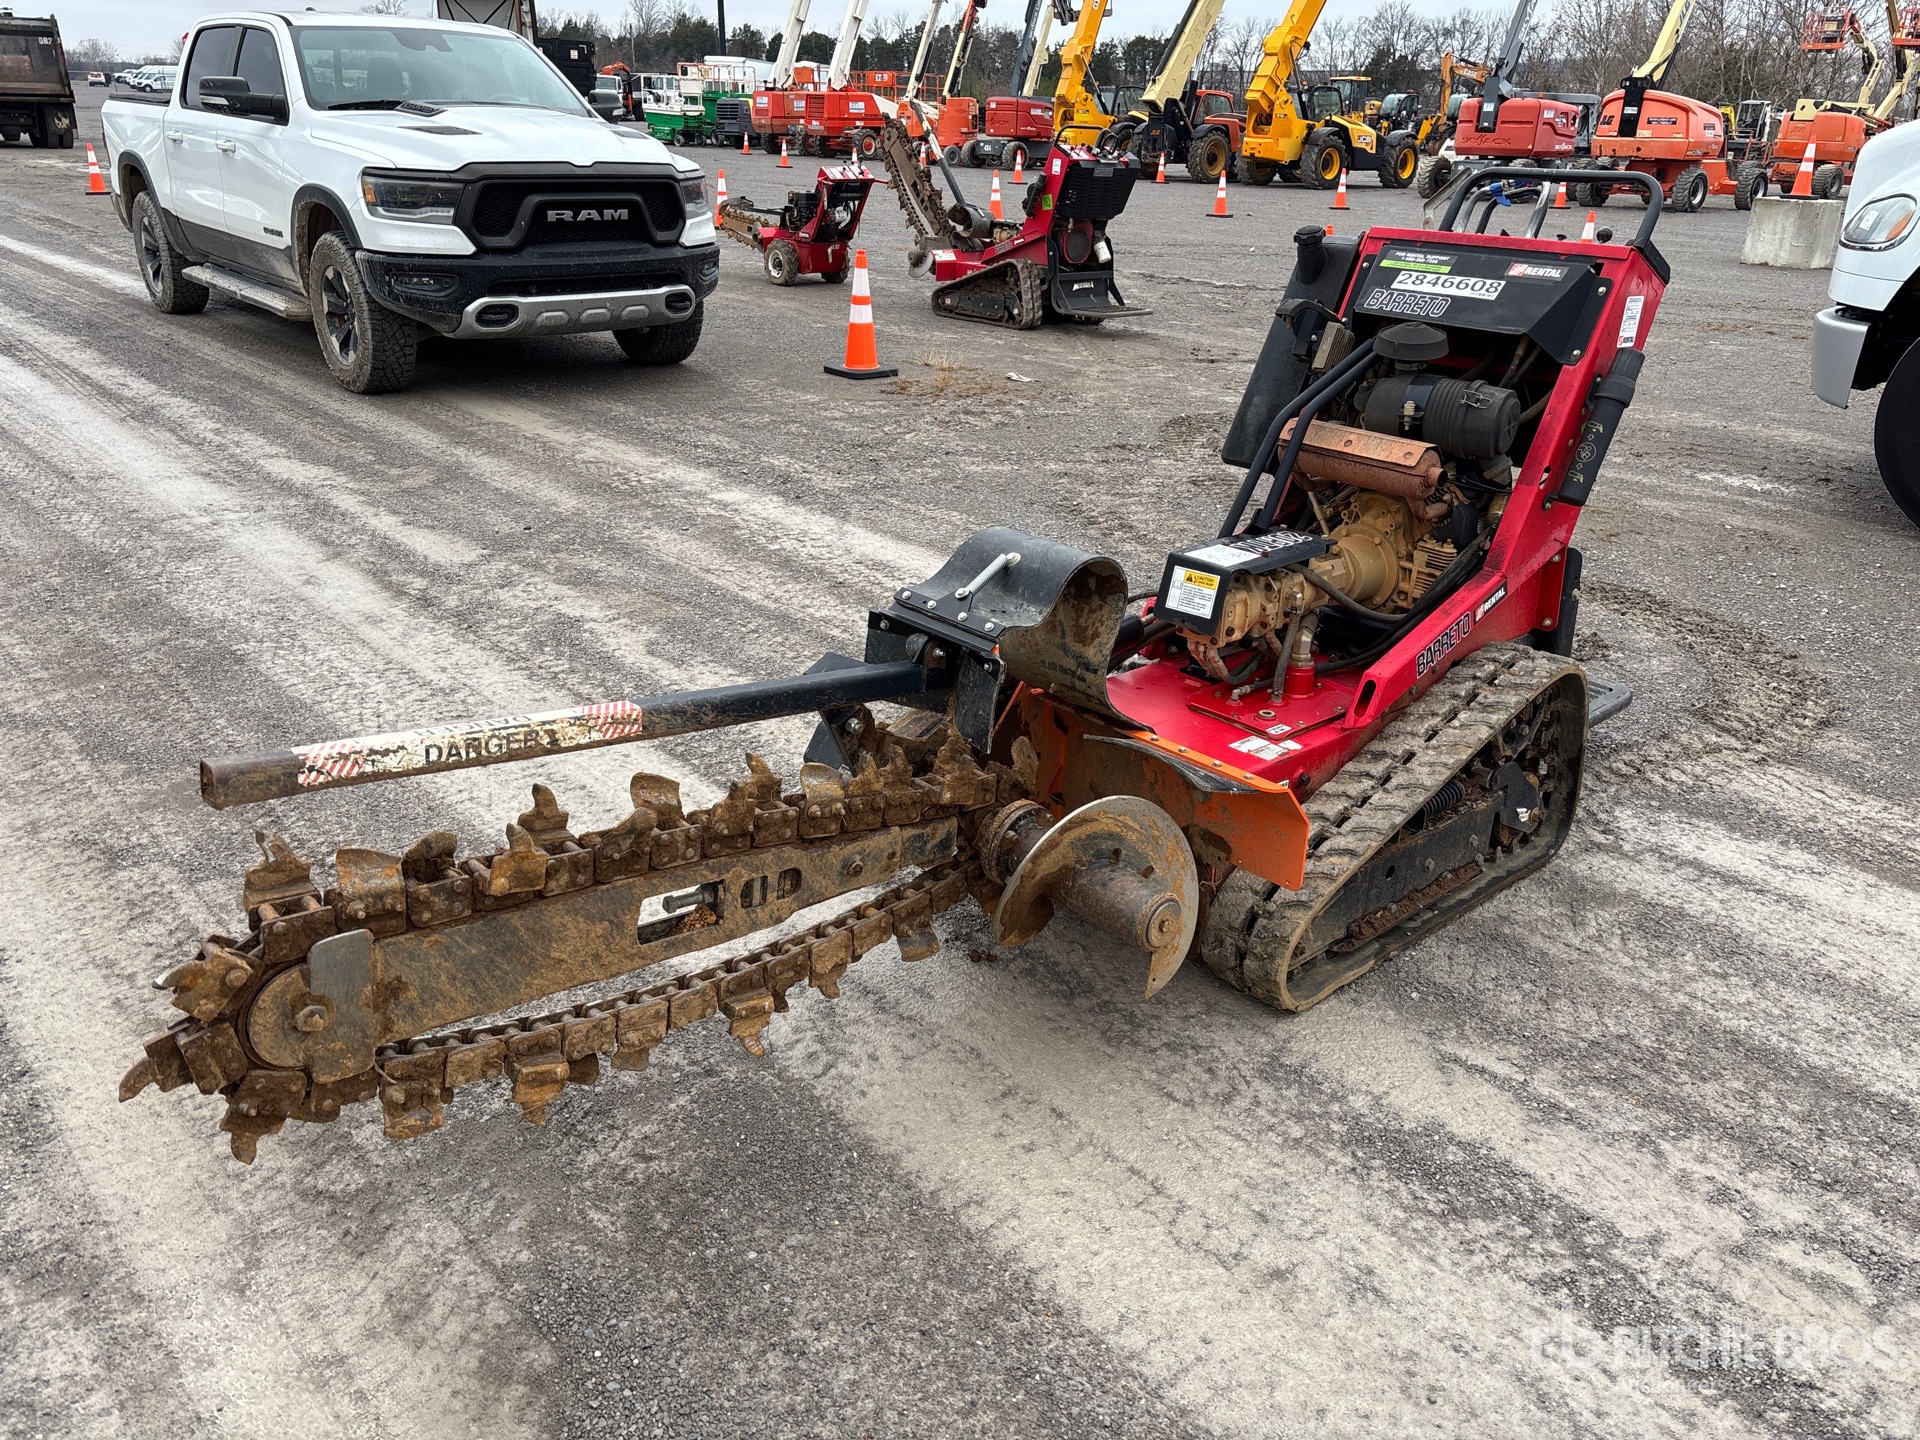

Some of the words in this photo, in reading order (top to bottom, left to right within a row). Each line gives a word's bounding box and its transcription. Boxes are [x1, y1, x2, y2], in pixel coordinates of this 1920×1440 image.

[1463, 69, 1478, 78] CASE
[1461, 134, 1511, 145] SKYJACK
[547, 209, 629, 222] RAM
[1525, 266, 1561, 278] RENTAL
[1400, 272, 1502, 295] 2846608
[1364, 289, 1451, 317] BARRETO
[1197, 575, 1215, 583] CAUTION
[1484, 587, 1506, 612] RENTAL
[1416, 610, 1471, 679] BARRETO
[424, 729, 541, 766] DANGER
